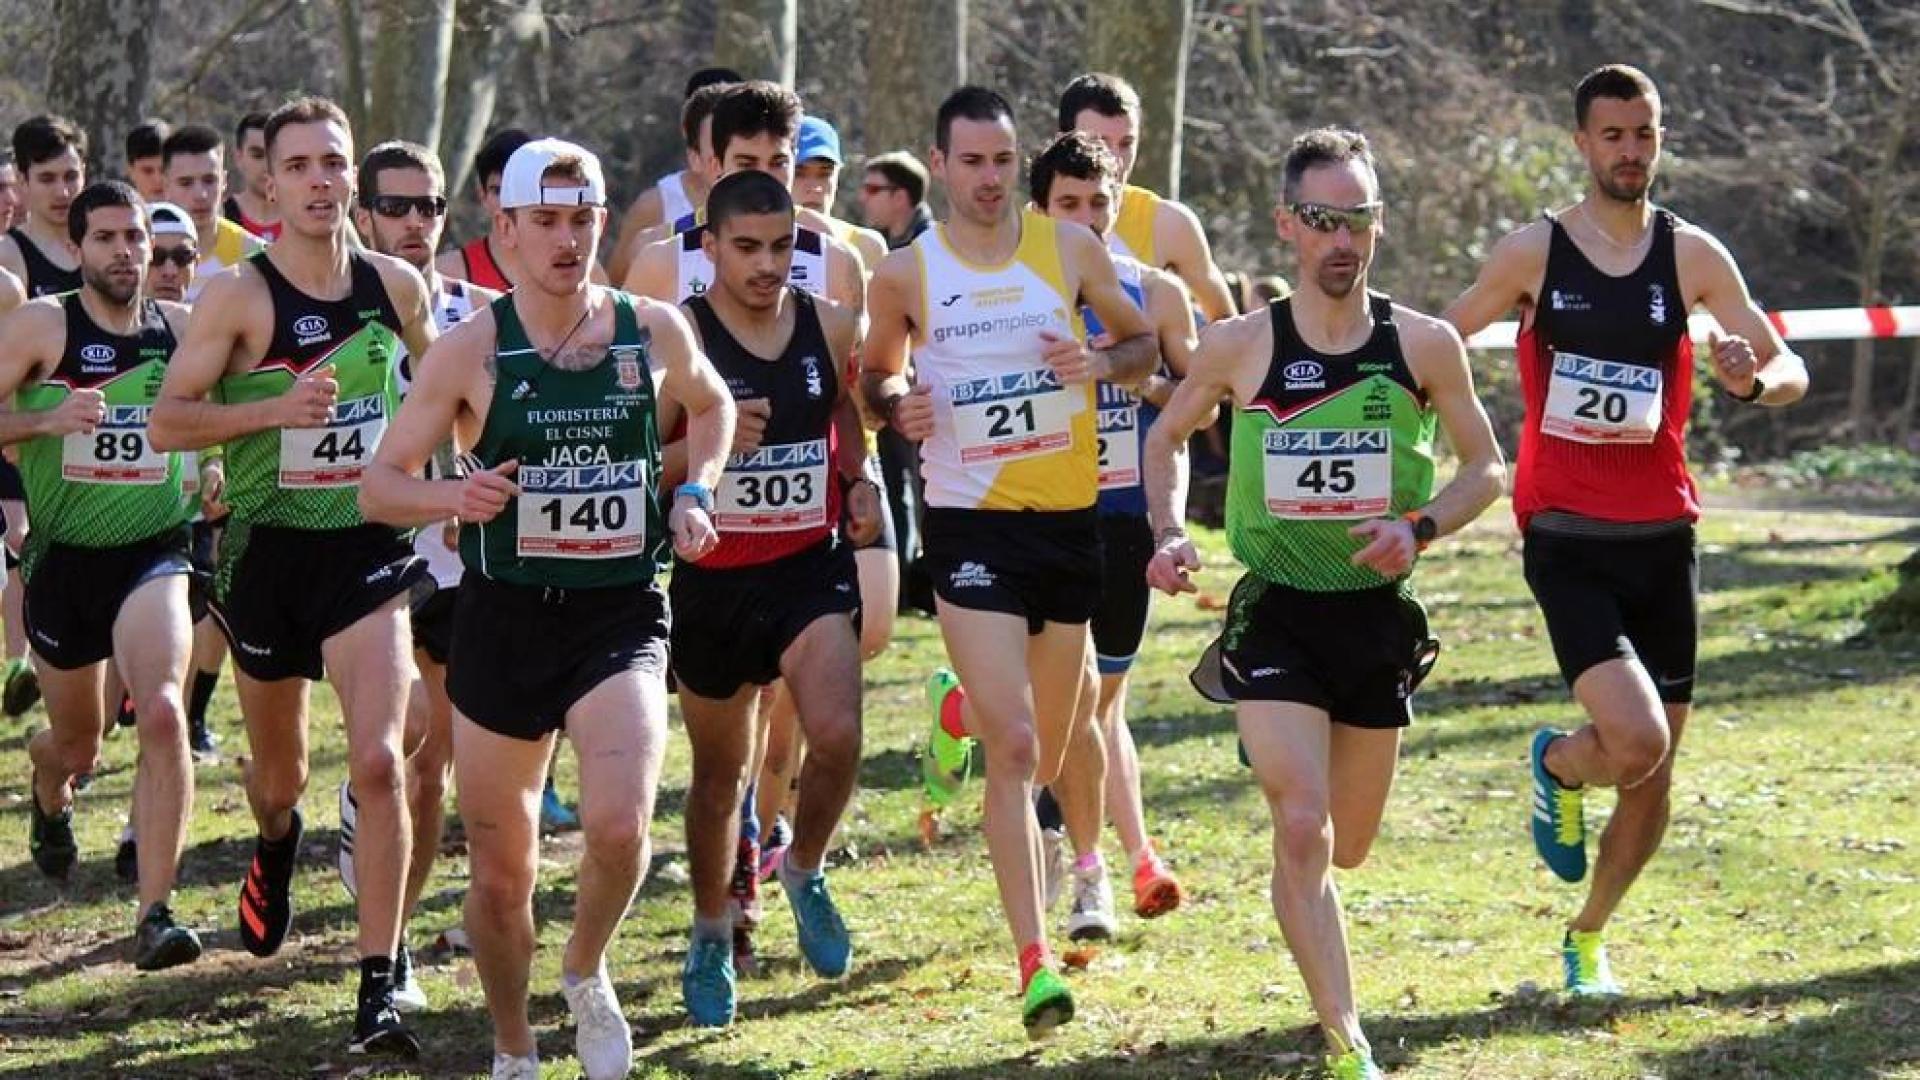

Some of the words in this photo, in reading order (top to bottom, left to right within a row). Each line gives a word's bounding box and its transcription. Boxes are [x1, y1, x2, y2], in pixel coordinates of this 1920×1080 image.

[952, 369, 1060, 400] BALAK
[985, 399, 1034, 437] 21
[1574, 387, 1627, 423] 20
[95, 432, 143, 461] 89
[313, 428, 365, 463] 44
[545, 428, 562, 441] EL
[565, 425, 614, 439] CISNE
[542, 443, 612, 467] JACA
[736, 472, 812, 508] 303
[1296, 459, 1356, 494] 45
[541, 495, 627, 532] 140
